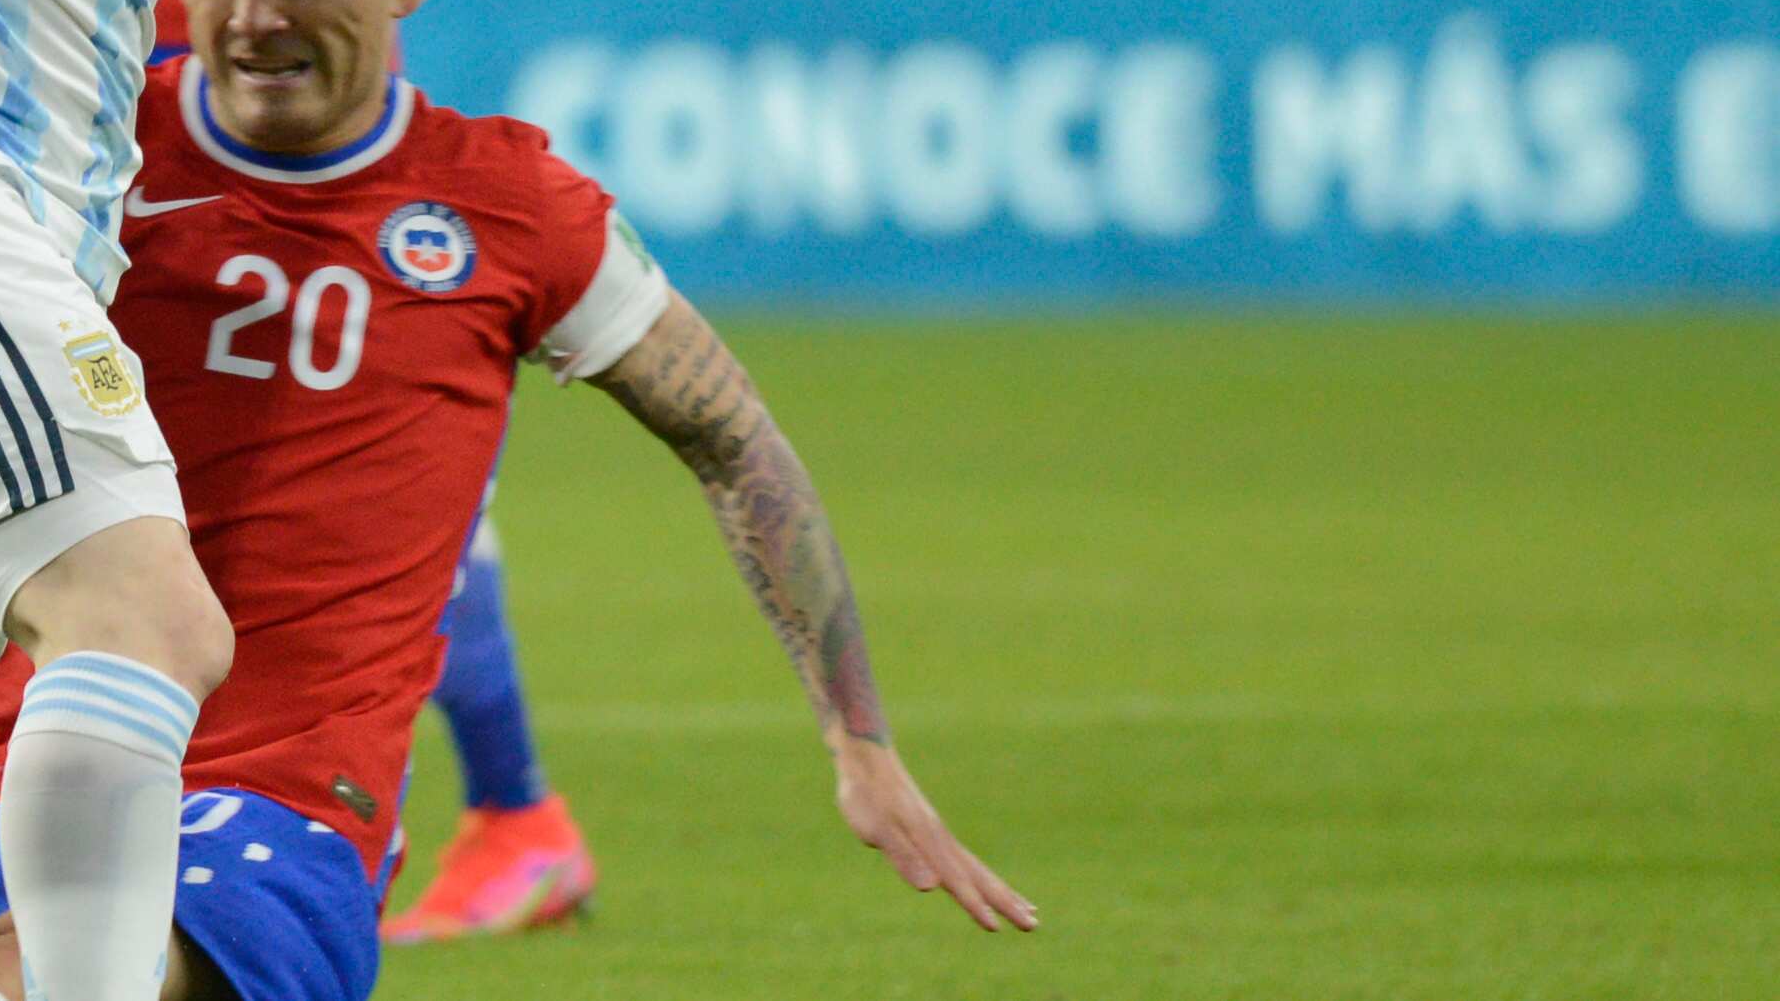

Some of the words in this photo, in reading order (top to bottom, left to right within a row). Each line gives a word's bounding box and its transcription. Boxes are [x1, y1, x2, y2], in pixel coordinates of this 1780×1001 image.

[508, 39, 1214, 235] CONOCE
[1252, 11, 1648, 233] MÁS
[204, 254, 372, 391] 20
